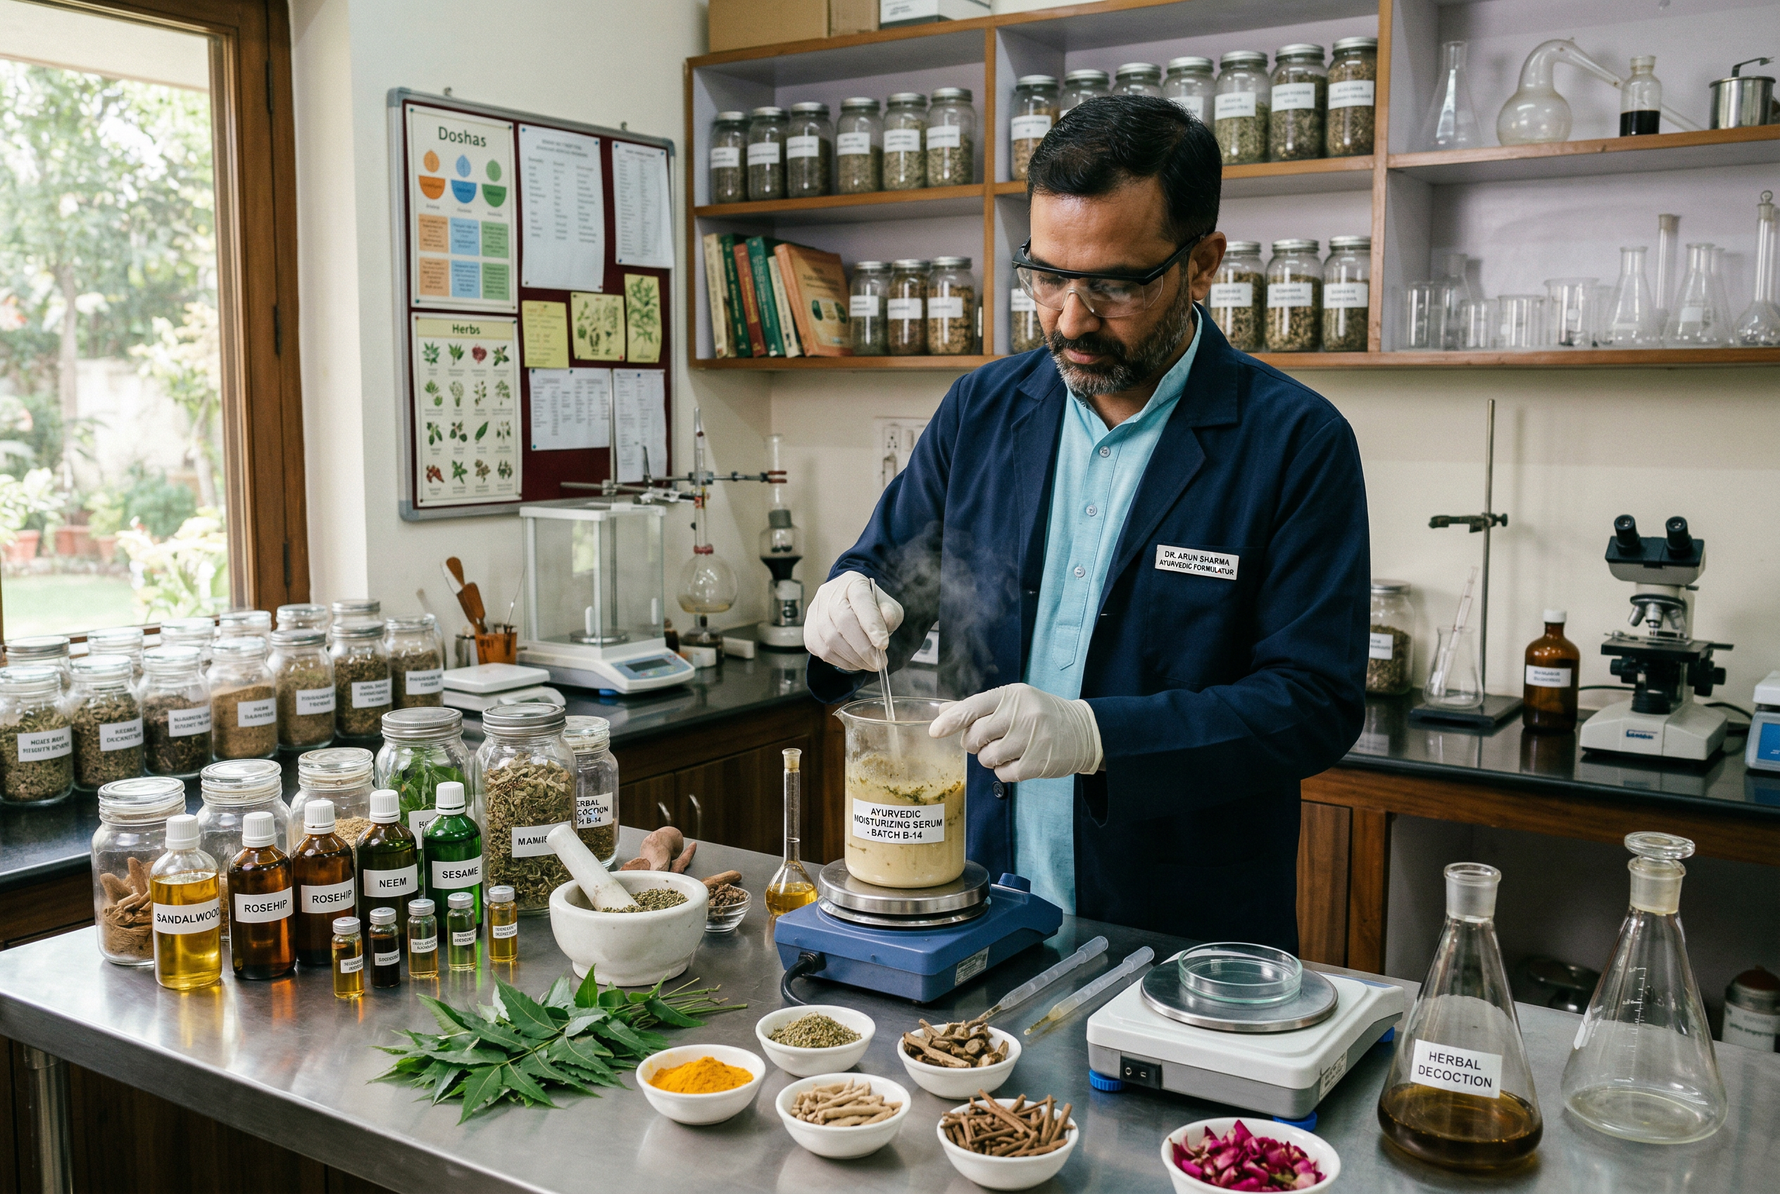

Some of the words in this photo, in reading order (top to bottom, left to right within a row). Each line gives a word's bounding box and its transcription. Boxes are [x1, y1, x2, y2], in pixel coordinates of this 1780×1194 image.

[438, 126, 487, 148] Doshas
[452, 323, 481, 335] Herbs
[1159, 559, 1192, 569] AYURVEDIC
[1164, 550, 1176, 558] DR.
[1177, 552, 1198, 561] ARUN
[1199, 555, 1230, 566] SHARMA
[576, 799, 599, 807] ERBAL
[870, 807, 921, 819] AYURVEDIC
[854, 813, 911, 829] MOISTURIZING
[912, 818, 943, 829] SERUM
[871, 828, 901, 839] BATCH
[902, 831, 923, 840] B-14
[441, 865, 479, 879] SESAME
[379, 876, 407, 888] NEEM
[311, 889, 353, 904] ROSEHIP
[244, 899, 288, 913] ROSEHIP
[1428, 1050, 1482, 1071] HERBAL
[1417, 1064, 1493, 1088] DECOCTION
